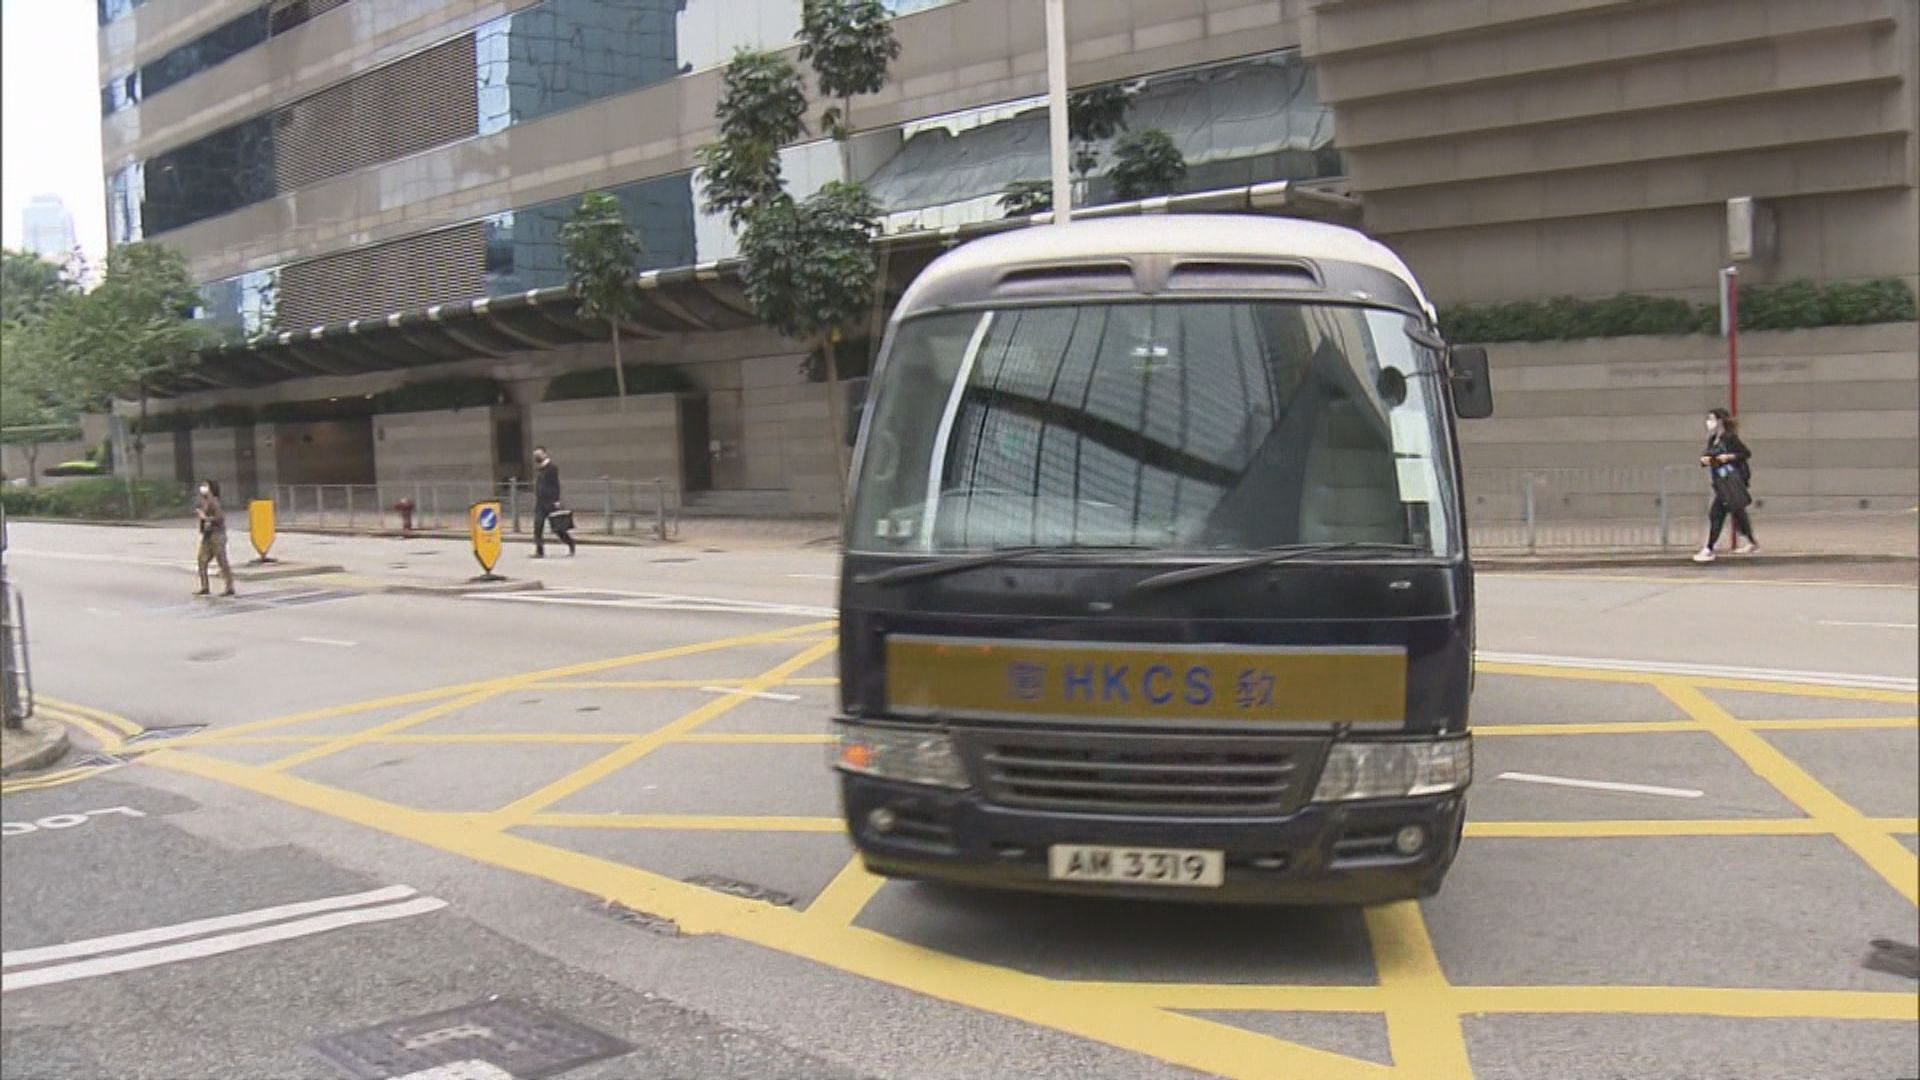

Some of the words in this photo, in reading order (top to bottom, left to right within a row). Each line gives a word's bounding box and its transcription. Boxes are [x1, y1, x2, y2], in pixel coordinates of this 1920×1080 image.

[1063, 662, 1214, 705] HKCS
[1067, 850, 1112, 876] AM
[1123, 852, 1206, 880] 3319
